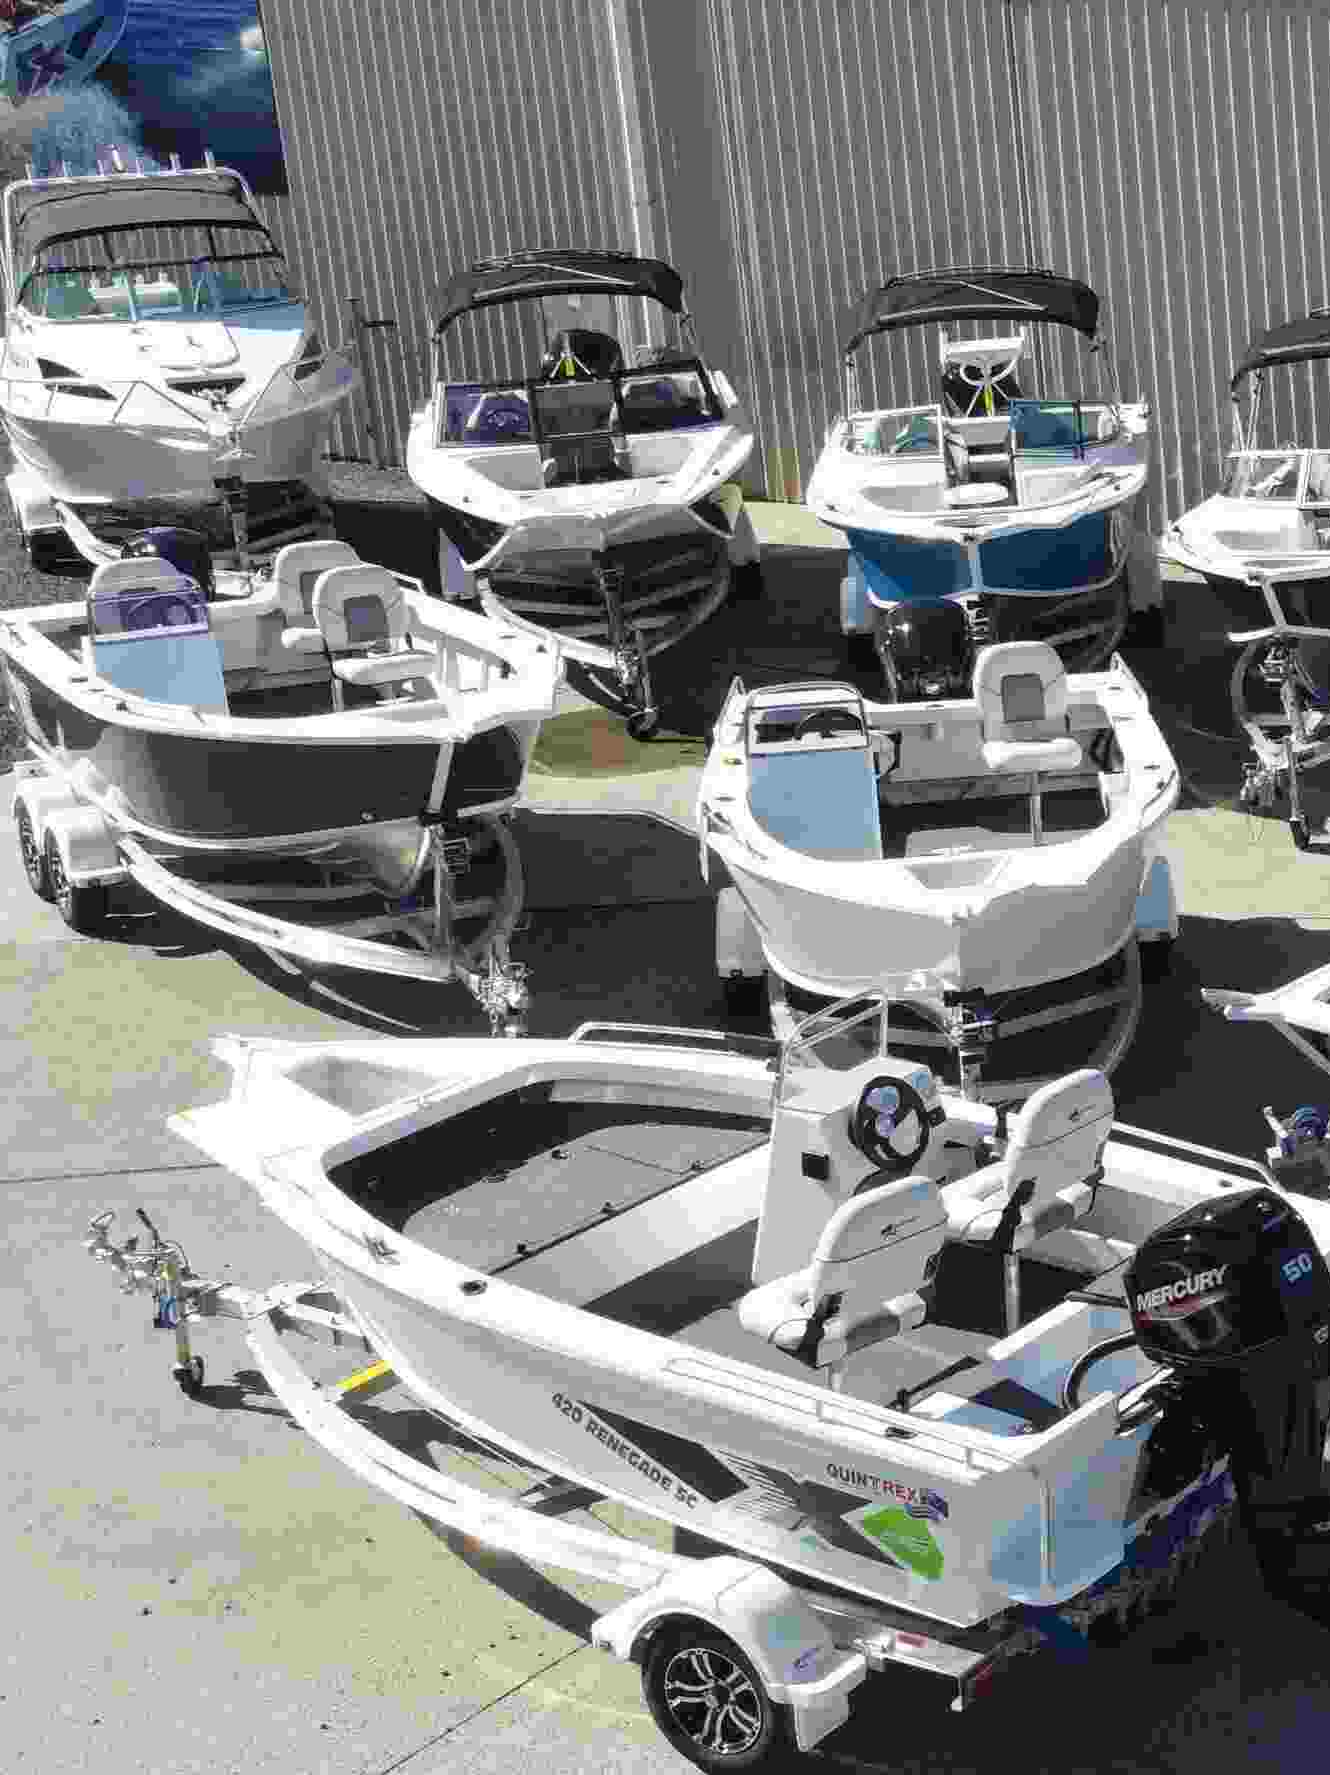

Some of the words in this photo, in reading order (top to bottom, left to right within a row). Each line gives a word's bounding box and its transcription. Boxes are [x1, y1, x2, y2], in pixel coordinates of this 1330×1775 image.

[1136, 1265, 1230, 1312] MERCURY
[1283, 1253, 1313, 1284] 50
[551, 1392, 583, 1424] 420
[585, 1416, 673, 1491] RENEGADE
[825, 1463, 919, 1504] QUINTREX
